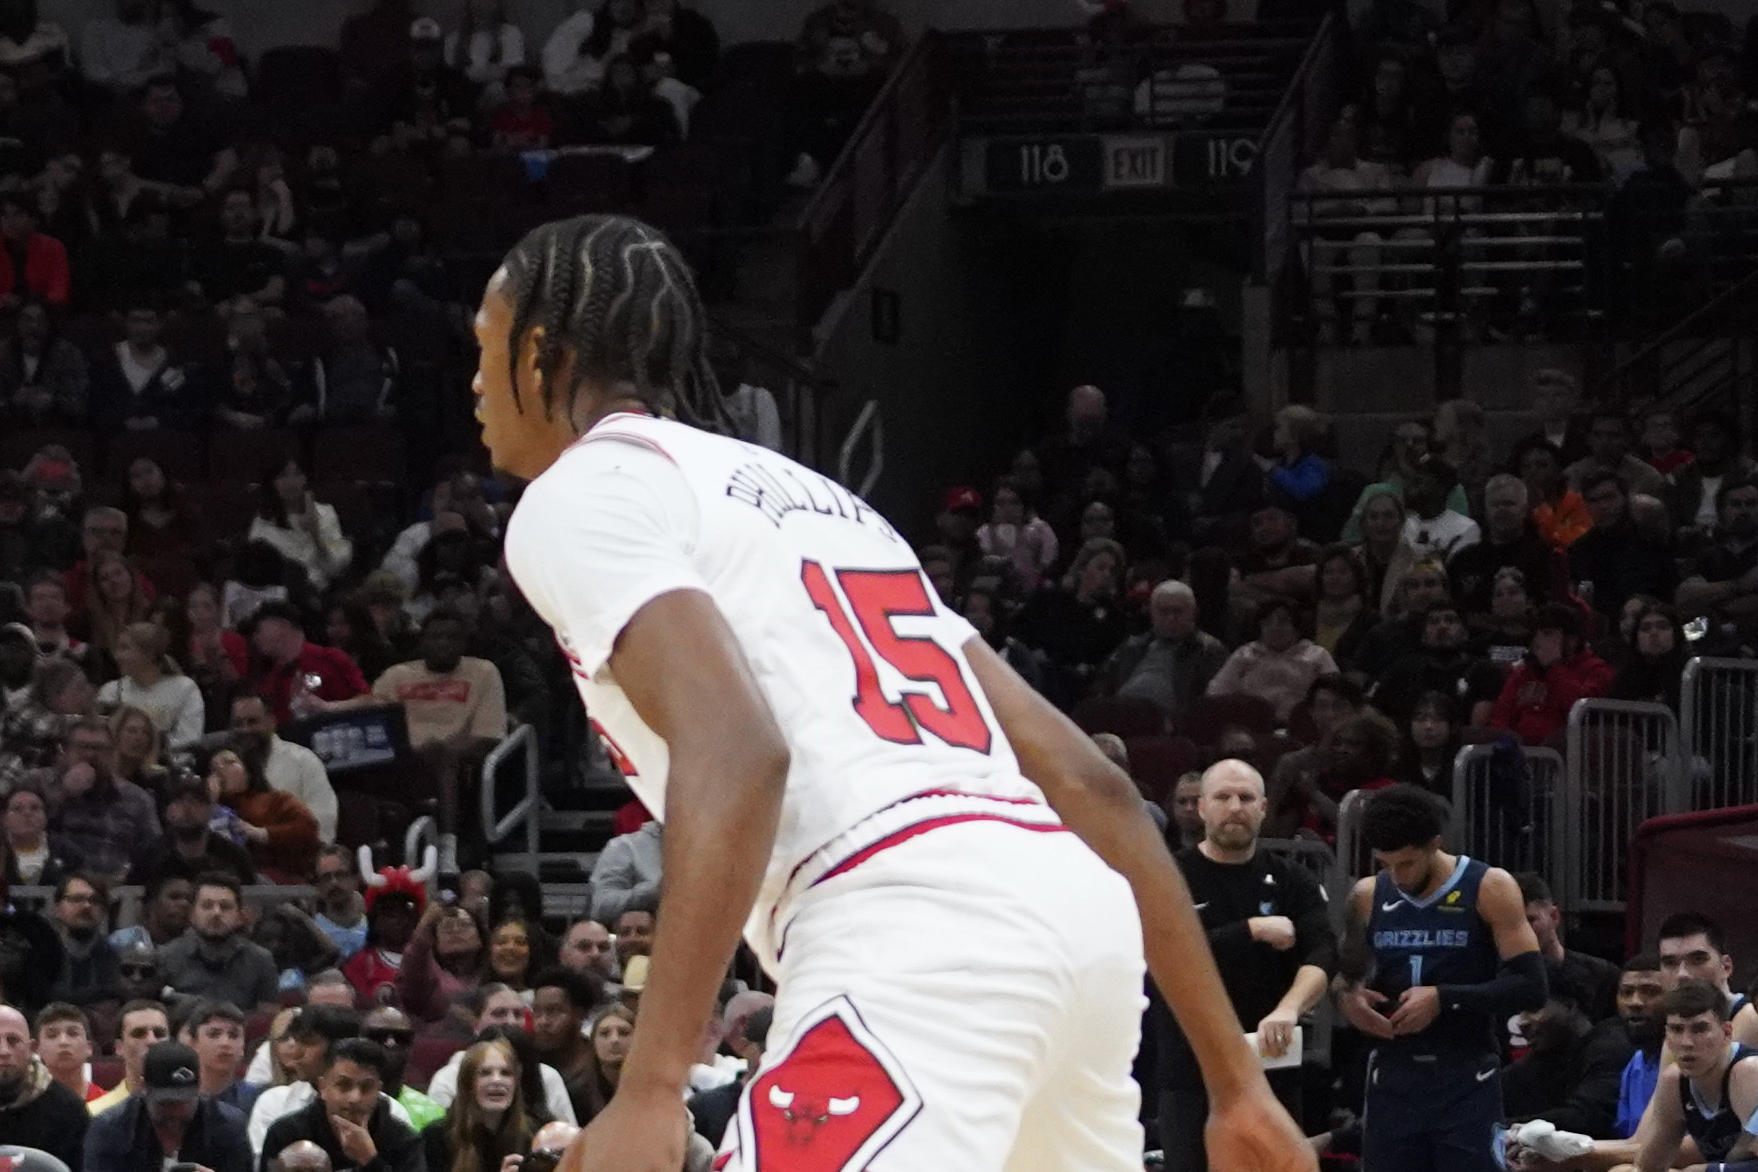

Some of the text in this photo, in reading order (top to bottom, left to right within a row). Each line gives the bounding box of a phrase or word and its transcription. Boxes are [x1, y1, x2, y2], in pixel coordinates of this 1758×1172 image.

[1019, 144, 1069, 185] 118
[1114, 147, 1160, 180] EXIT
[800, 556, 992, 757] 15
[1374, 929, 1468, 948] GRIZZLIES
[1409, 954, 1423, 986] 1
